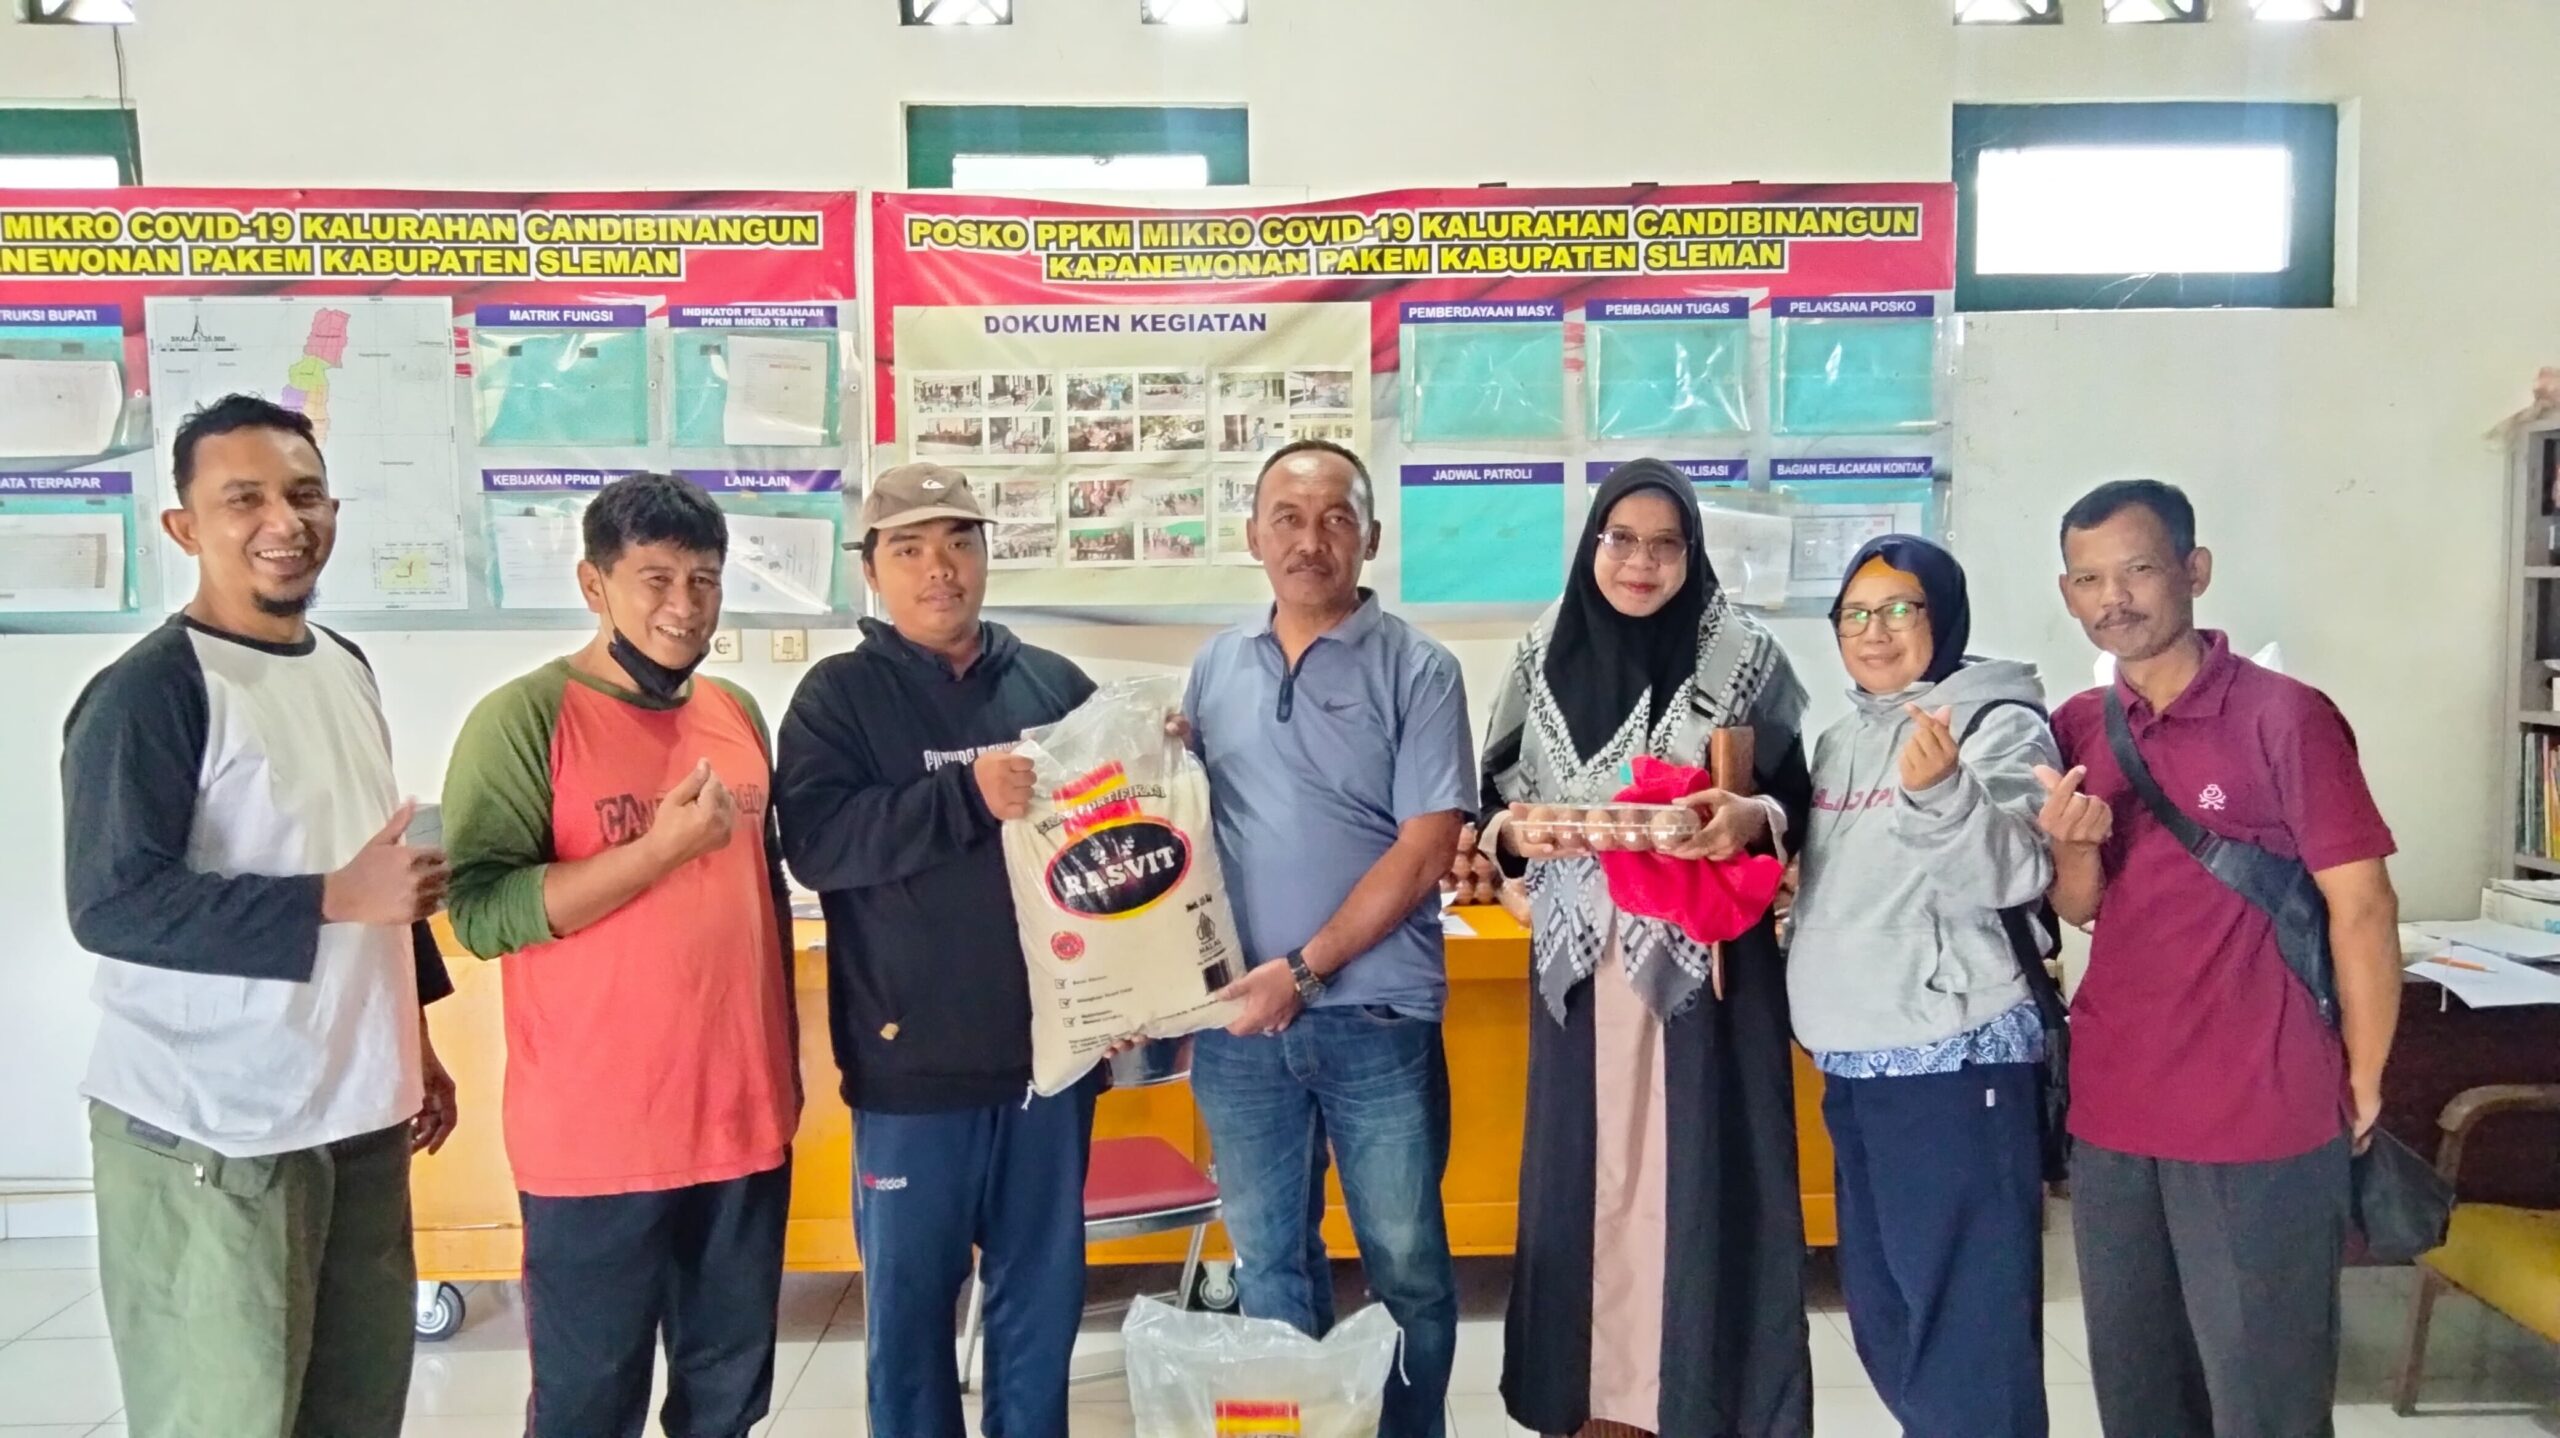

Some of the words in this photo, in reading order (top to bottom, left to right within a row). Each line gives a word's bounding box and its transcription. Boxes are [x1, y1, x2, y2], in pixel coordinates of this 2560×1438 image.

[2, 214, 120, 240] MIKRO
[130, 214, 292, 240] COVID-19
[303, 215, 517, 241] KALURAHAN
[525, 216, 816, 243] CANDIBINANGUN
[911, 219, 1027, 249] POSKO
[1036, 223, 1132, 249] PPKM
[1142, 220, 1252, 247] MIKRO
[1262, 215, 1412, 245] COVID-19
[1421, 213, 1626, 240] KALURAHAN
[1636, 210, 1916, 236] CANDIBINANGUN
[0, 247, 181, 274] NEWONAN
[191, 246, 313, 273] PAKEM
[323, 248, 528, 274] KABUPATEN
[538, 249, 679, 275] SLEMAN
[1049, 253, 1308, 279] KAPANEWONAN
[1320, 247, 1430, 272] PAKEM
[1440, 245, 1637, 271] KABUPATEN
[1647, 242, 1782, 269] SLEMAN
[682, 307, 742, 317] INDIKATOR
[744, 307, 824, 317] PELAKSANAAN
[1408, 306, 1514, 319] PEMBERDAYAAN
[1516, 305, 1554, 317] MASY.
[1605, 303, 1683, 316] PEMBAGIAN
[1685, 302, 1730, 315] TUGAS
[1789, 301, 1869, 313] PELAKSANA
[1870, 300, 1917, 312] POSKO
[47, 309, 98, 322] BUPATI
[509, 309, 561, 322] MATRIK
[562, 309, 614, 322] FUNGSI
[700, 317, 732, 327] PPKM
[734, 317, 771, 327] MIKRO
[773, 317, 789, 327] TK
[791, 317, 806, 327] RT
[984, 314, 1120, 334] DOKUMEN
[1131, 313, 1267, 333] KEGIATAN
[1432, 469, 1482, 481] JADWAL
[1483, 468, 1532, 480] PATROLI
[1777, 463, 1817, 476] BAGIAN
[1818, 463, 1882, 475] PELACAKAN
[1883, 462, 1925, 474] KONTAK
[28, 476, 101, 489] TERPAPAR
[492, 474, 562, 486] KEBIJAKAN
[564, 474, 601, 485] PPKM
[724, 476, 790, 487] LAIN-LAIN
[1063, 846, 1175, 899] RASVIT
